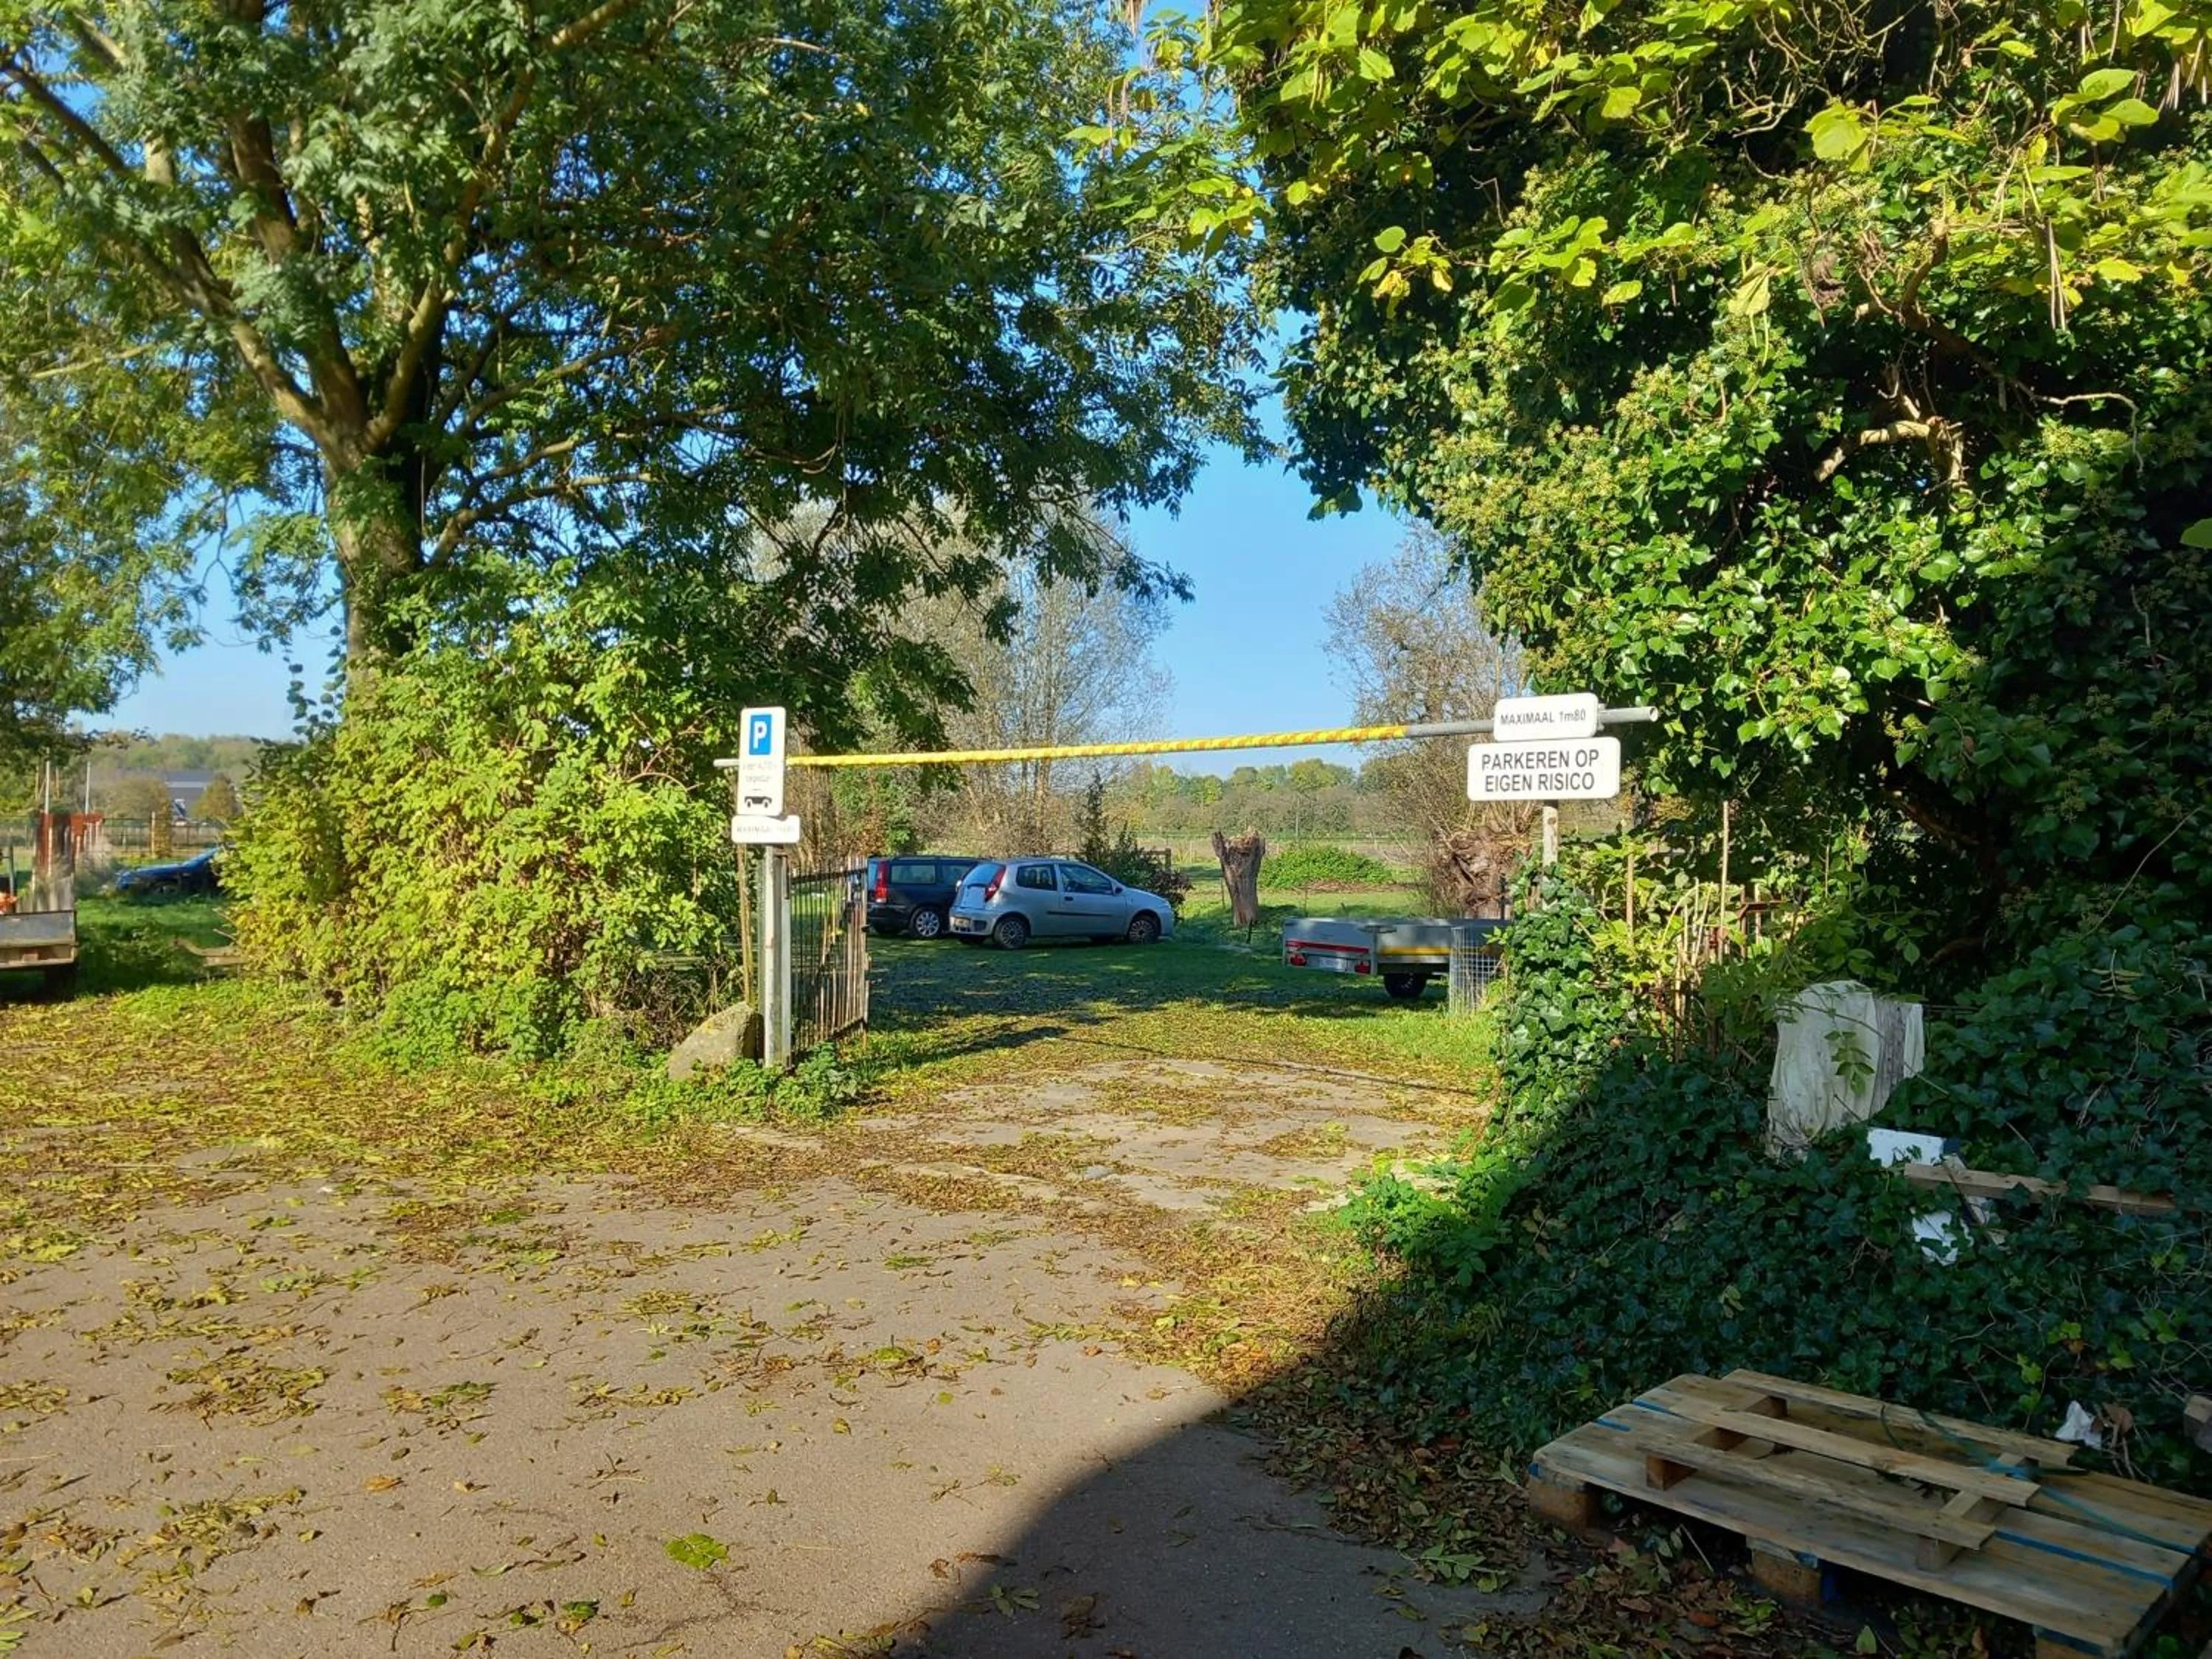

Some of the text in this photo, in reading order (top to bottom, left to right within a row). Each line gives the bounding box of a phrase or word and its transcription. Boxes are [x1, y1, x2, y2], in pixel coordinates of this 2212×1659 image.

[1500, 709, 1586, 726] MAXIMAAL 1m80
[753, 720, 768, 749] P
[1481, 748, 1599, 771] PARKEREN OP
[1484, 772, 1595, 792] EIGEN RISICO
